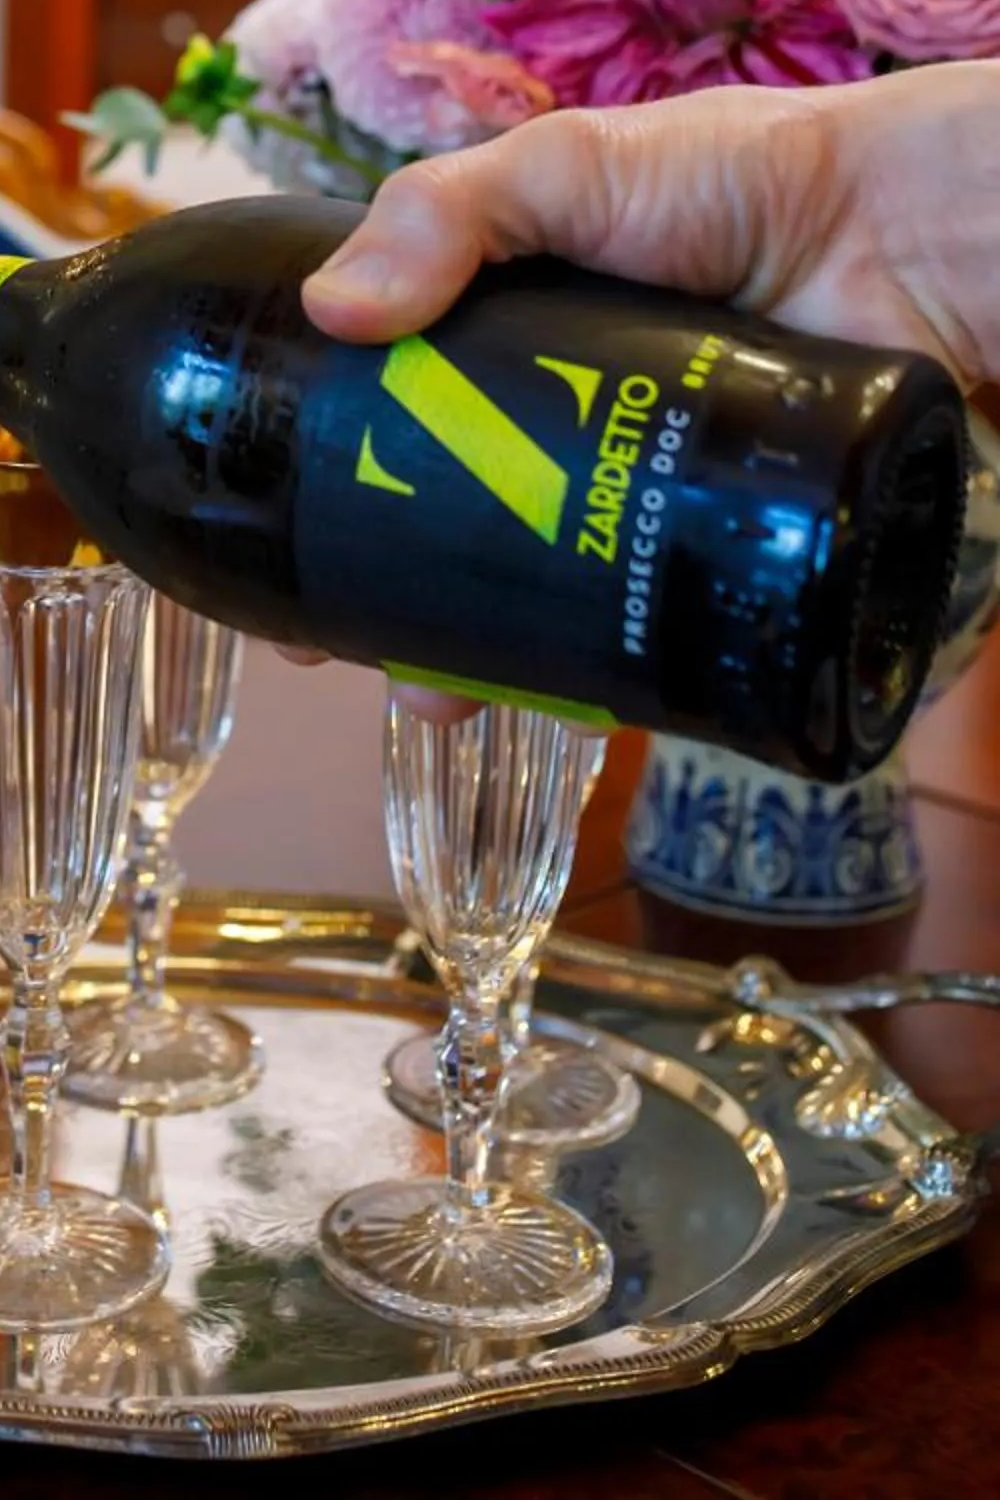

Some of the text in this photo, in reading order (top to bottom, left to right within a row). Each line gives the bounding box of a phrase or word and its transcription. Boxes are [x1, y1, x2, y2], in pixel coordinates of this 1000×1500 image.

[577, 375, 659, 563] ZARDETTO
[623, 488, 666, 655] PROSECCO
[650, 407, 690, 475] DOC
